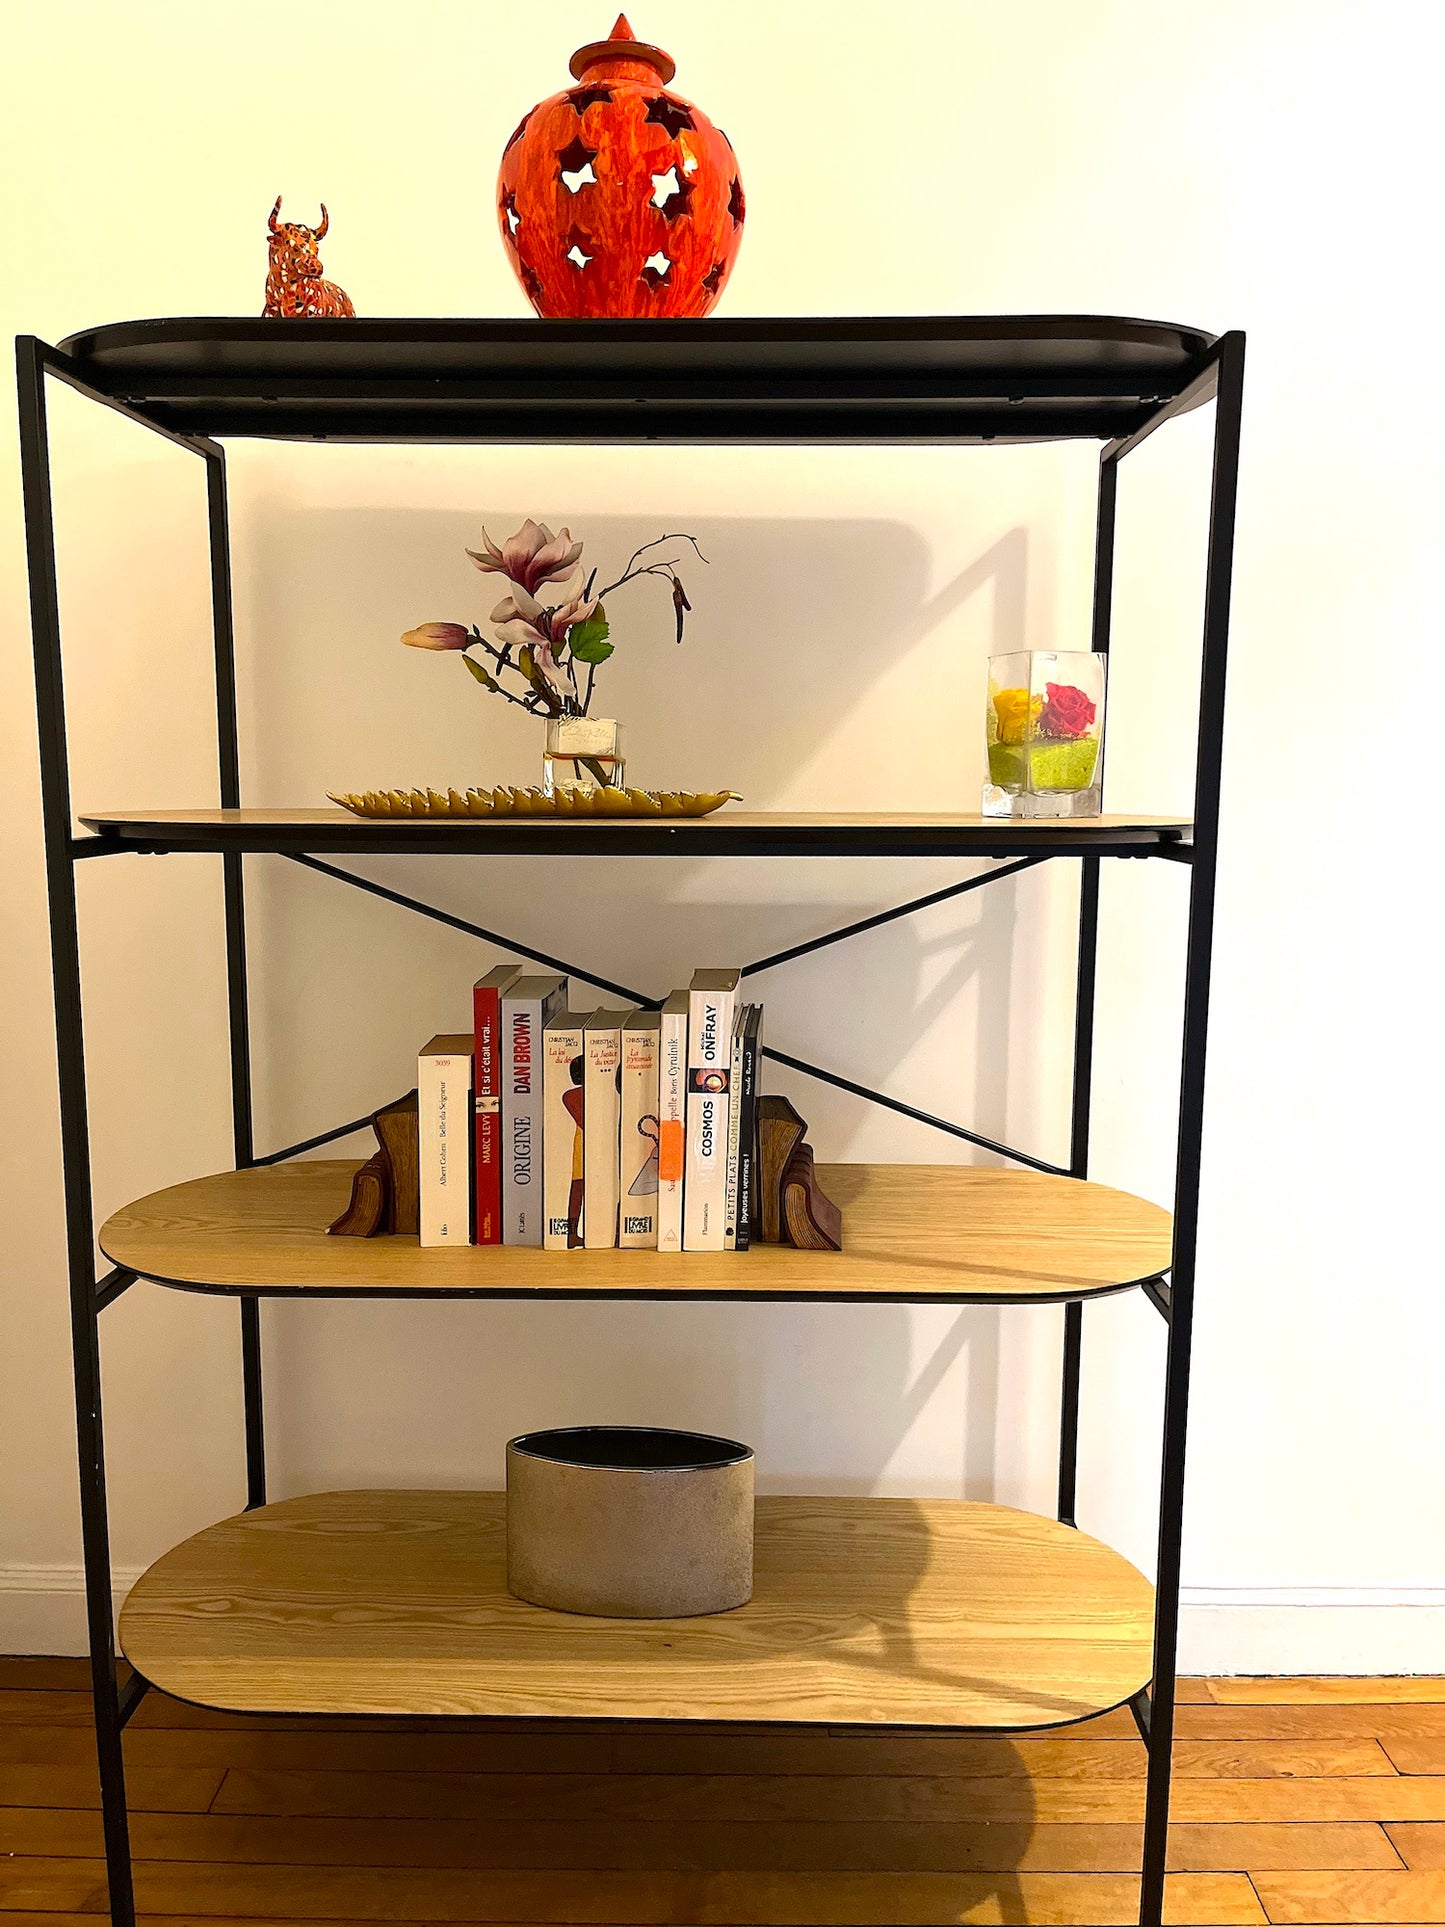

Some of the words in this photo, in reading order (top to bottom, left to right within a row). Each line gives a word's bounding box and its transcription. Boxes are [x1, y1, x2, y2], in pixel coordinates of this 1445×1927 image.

[513, 1013, 531, 1064] BROWN
[704, 1005, 716, 1060] ONFRAY
[481, 1045, 491, 1073] c'était
[549, 1047, 558, 1056] La
[554, 1056, 563, 1064] du
[590, 1049, 599, 1058] La
[595, 1057, 603, 1066] du
[630, 1048, 639, 1057] La
[668, 1038, 680, 1076] Cyrulnik
[481, 1086, 491, 1096] Et
[482, 1075, 491, 1084] si
[513, 1066, 531, 1094] DAN
[732, 1064, 740, 1091] CHEF
[439, 1081, 448, 1110] Seigneur
[732, 1095, 739, 1111] UN
[439, 1111, 447, 1121] du
[439, 1121, 447, 1138] Belle
[482, 1114, 491, 1136] LEVY
[702, 1101, 713, 1157] COSMOS
[730, 1114, 739, 1151] COMME
[482, 1137, 491, 1164] MARC
[513, 1116, 531, 1186] ORIGINE
[729, 1155, 737, 1185] PLATS
[742, 1158, 750, 1190] verrines
[727, 1187, 736, 1221] PETITS
[740, 1190, 749, 1224] Joyeuses
[629, 1221, 649, 1229] LIVRE
